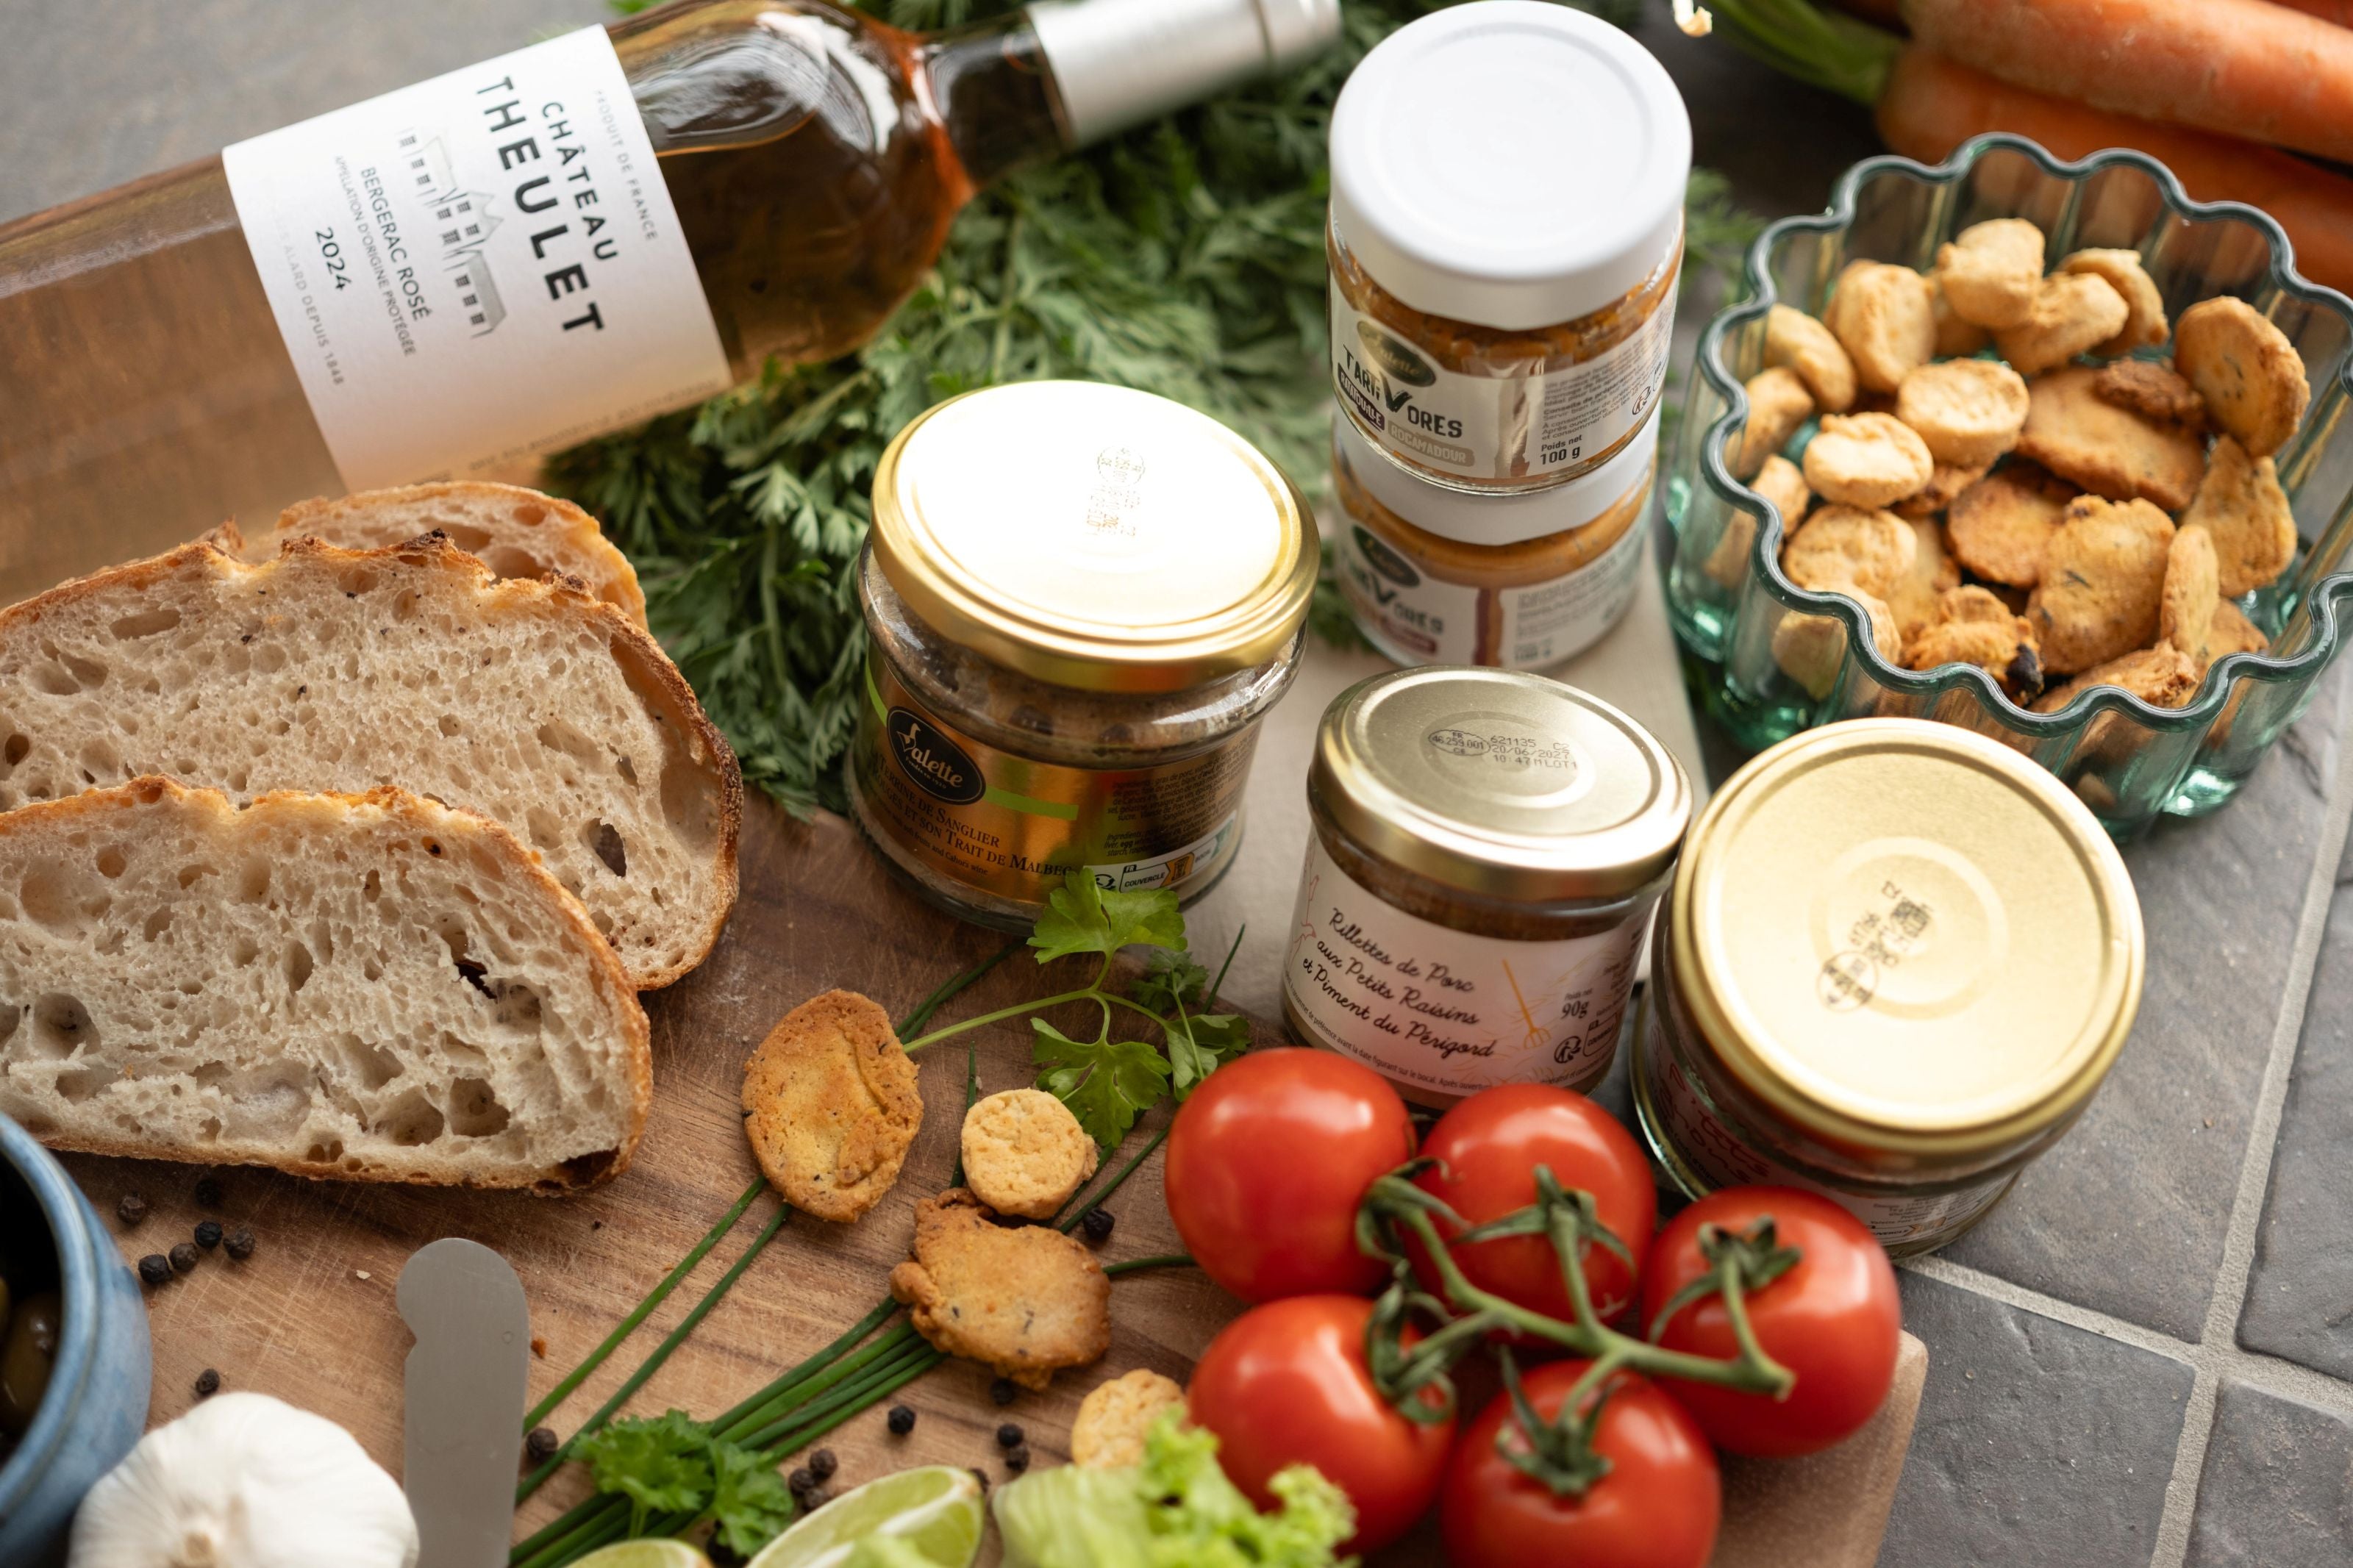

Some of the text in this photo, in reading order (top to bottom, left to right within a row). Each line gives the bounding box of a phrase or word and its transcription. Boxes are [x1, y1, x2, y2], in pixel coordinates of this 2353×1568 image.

[476, 76, 605, 333] THEULET
[542, 101, 619, 262] CHÂTEAU
[617, 153, 633, 174] DE
[627, 179, 658, 241] FRANCE
[315, 226, 352, 292] 2024
[361, 166, 434, 322] BERGERAC ROSÉ
[301, 294, 329, 348] DEPUIS
[1390, 423, 1467, 464] ROCAMADOUR
[1540, 446, 1581, 465] 100 g
[1541, 434, 1583, 452] Poids net
[1490, 734, 1536, 748] 621135
[1491, 743, 1571, 759] 20/06/2027
[904, 806, 918, 823] ET
[919, 818, 942, 839] SON
[946, 828, 984, 859] TRAIT
[987, 851, 1007, 867] DE
[918, 797, 934, 817] DE
[936, 809, 1001, 848] SANGLIER
[932, 845, 945, 857] and
[971, 863, 988, 876] wine
[1124, 871, 1165, 888] COUVERCLE
[1329, 907, 1475, 993] Rillettes de Porc
[1302, 957, 1313, 975] et
[1313, 963, 1371, 1021] Piment
[1373, 1014, 1401, 1036] du
[1404, 1020, 1498, 1060] Périgord
[1316, 939, 1481, 1025] aux Petits Raisins
[1560, 1000, 1590, 1020] 90g
[1337, 1036, 1352, 1051] avant
[1358, 1048, 1373, 1062] date
[1372, 1054, 1398, 1072] figurant
[1399, 1066, 1409, 1076] sur
[1410, 1068, 1417, 1078] le
[1438, 1077, 1458, 1089] Après
